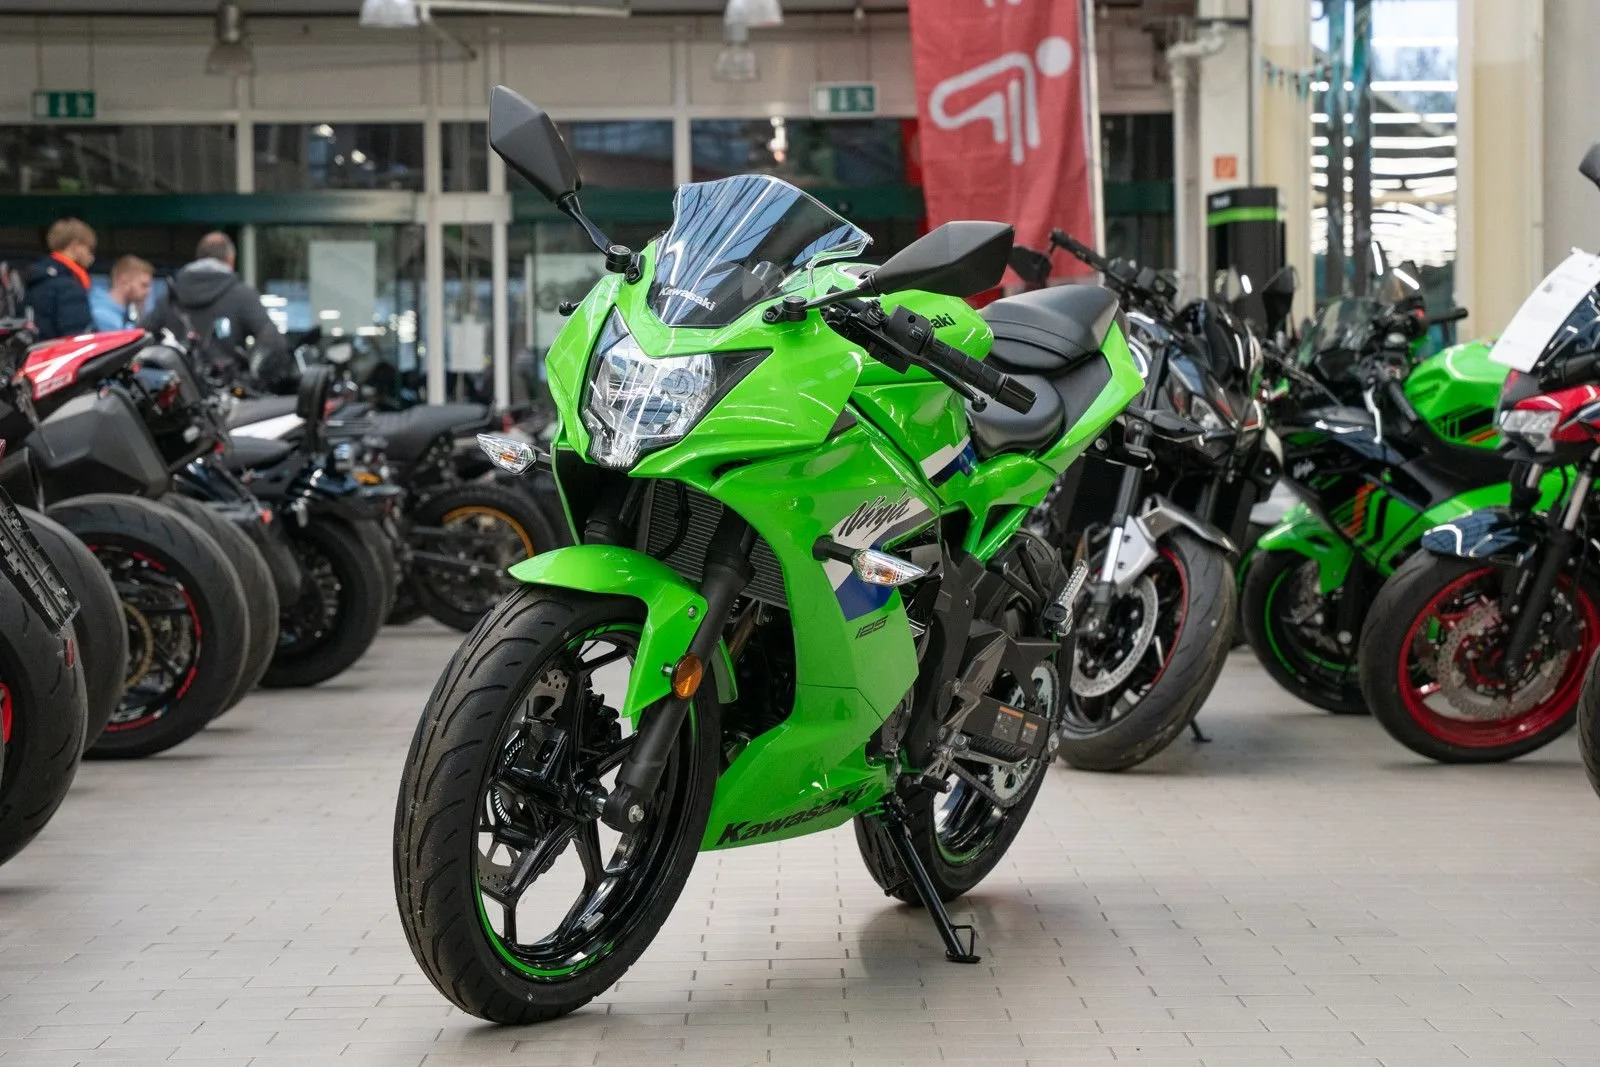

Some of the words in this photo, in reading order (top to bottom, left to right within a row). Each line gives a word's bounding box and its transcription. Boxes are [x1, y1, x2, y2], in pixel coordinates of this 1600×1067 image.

[658, 286, 717, 312] Kawasaki
[838, 488, 911, 541] Ninja
[855, 614, 888, 639] 125
[716, 782, 869, 846] Kawasaki
